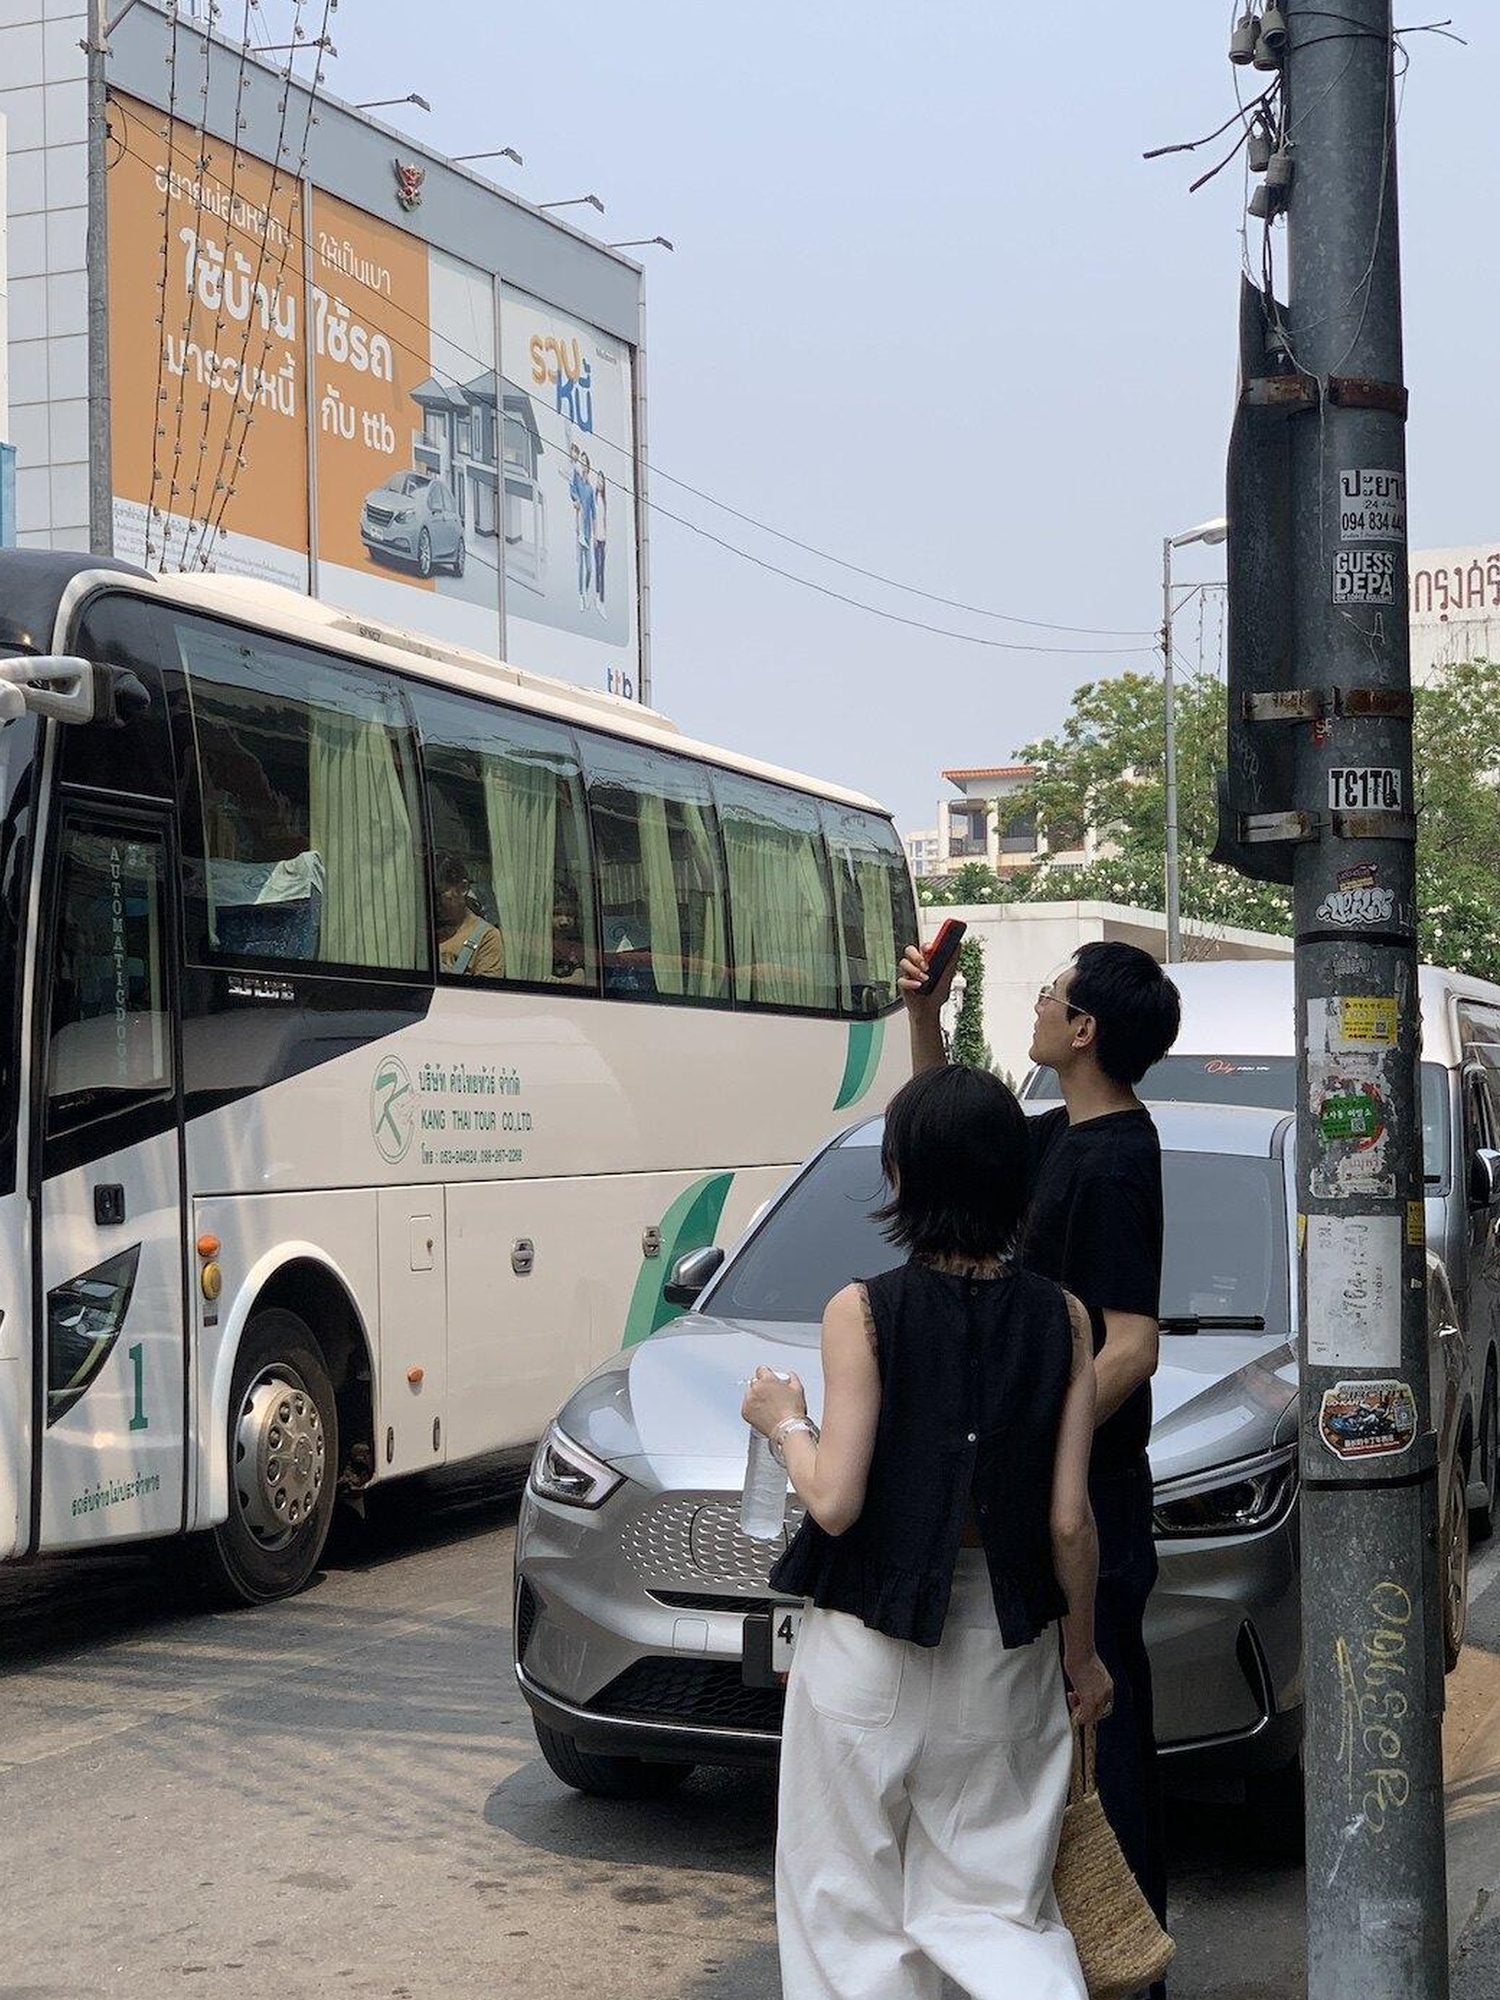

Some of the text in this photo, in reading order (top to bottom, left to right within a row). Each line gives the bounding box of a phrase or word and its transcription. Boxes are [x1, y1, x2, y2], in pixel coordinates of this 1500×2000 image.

[319, 231, 391, 296] ให้เป็นเบา
[179, 226, 393, 382] ใช้บ้าน ใช้รถ
[529, 334, 580, 385] รวบ
[166, 334, 396, 455] มารวบหนี้ กับ ttb
[556, 358, 593, 433] หนี้
[1342, 512, 1365, 531] 094
[1369, 512, 1389, 531] 834
[1335, 573, 1393, 595] DEPA
[1336, 551, 1393, 574] GUESS
[607, 667, 633, 700] ttb
[421, 1109, 446, 1131] KANG
[452, 1110, 472, 1131] THAI
[474, 1111, 497, 1131] TOUR
[129, 1343, 148, 1431] 1
